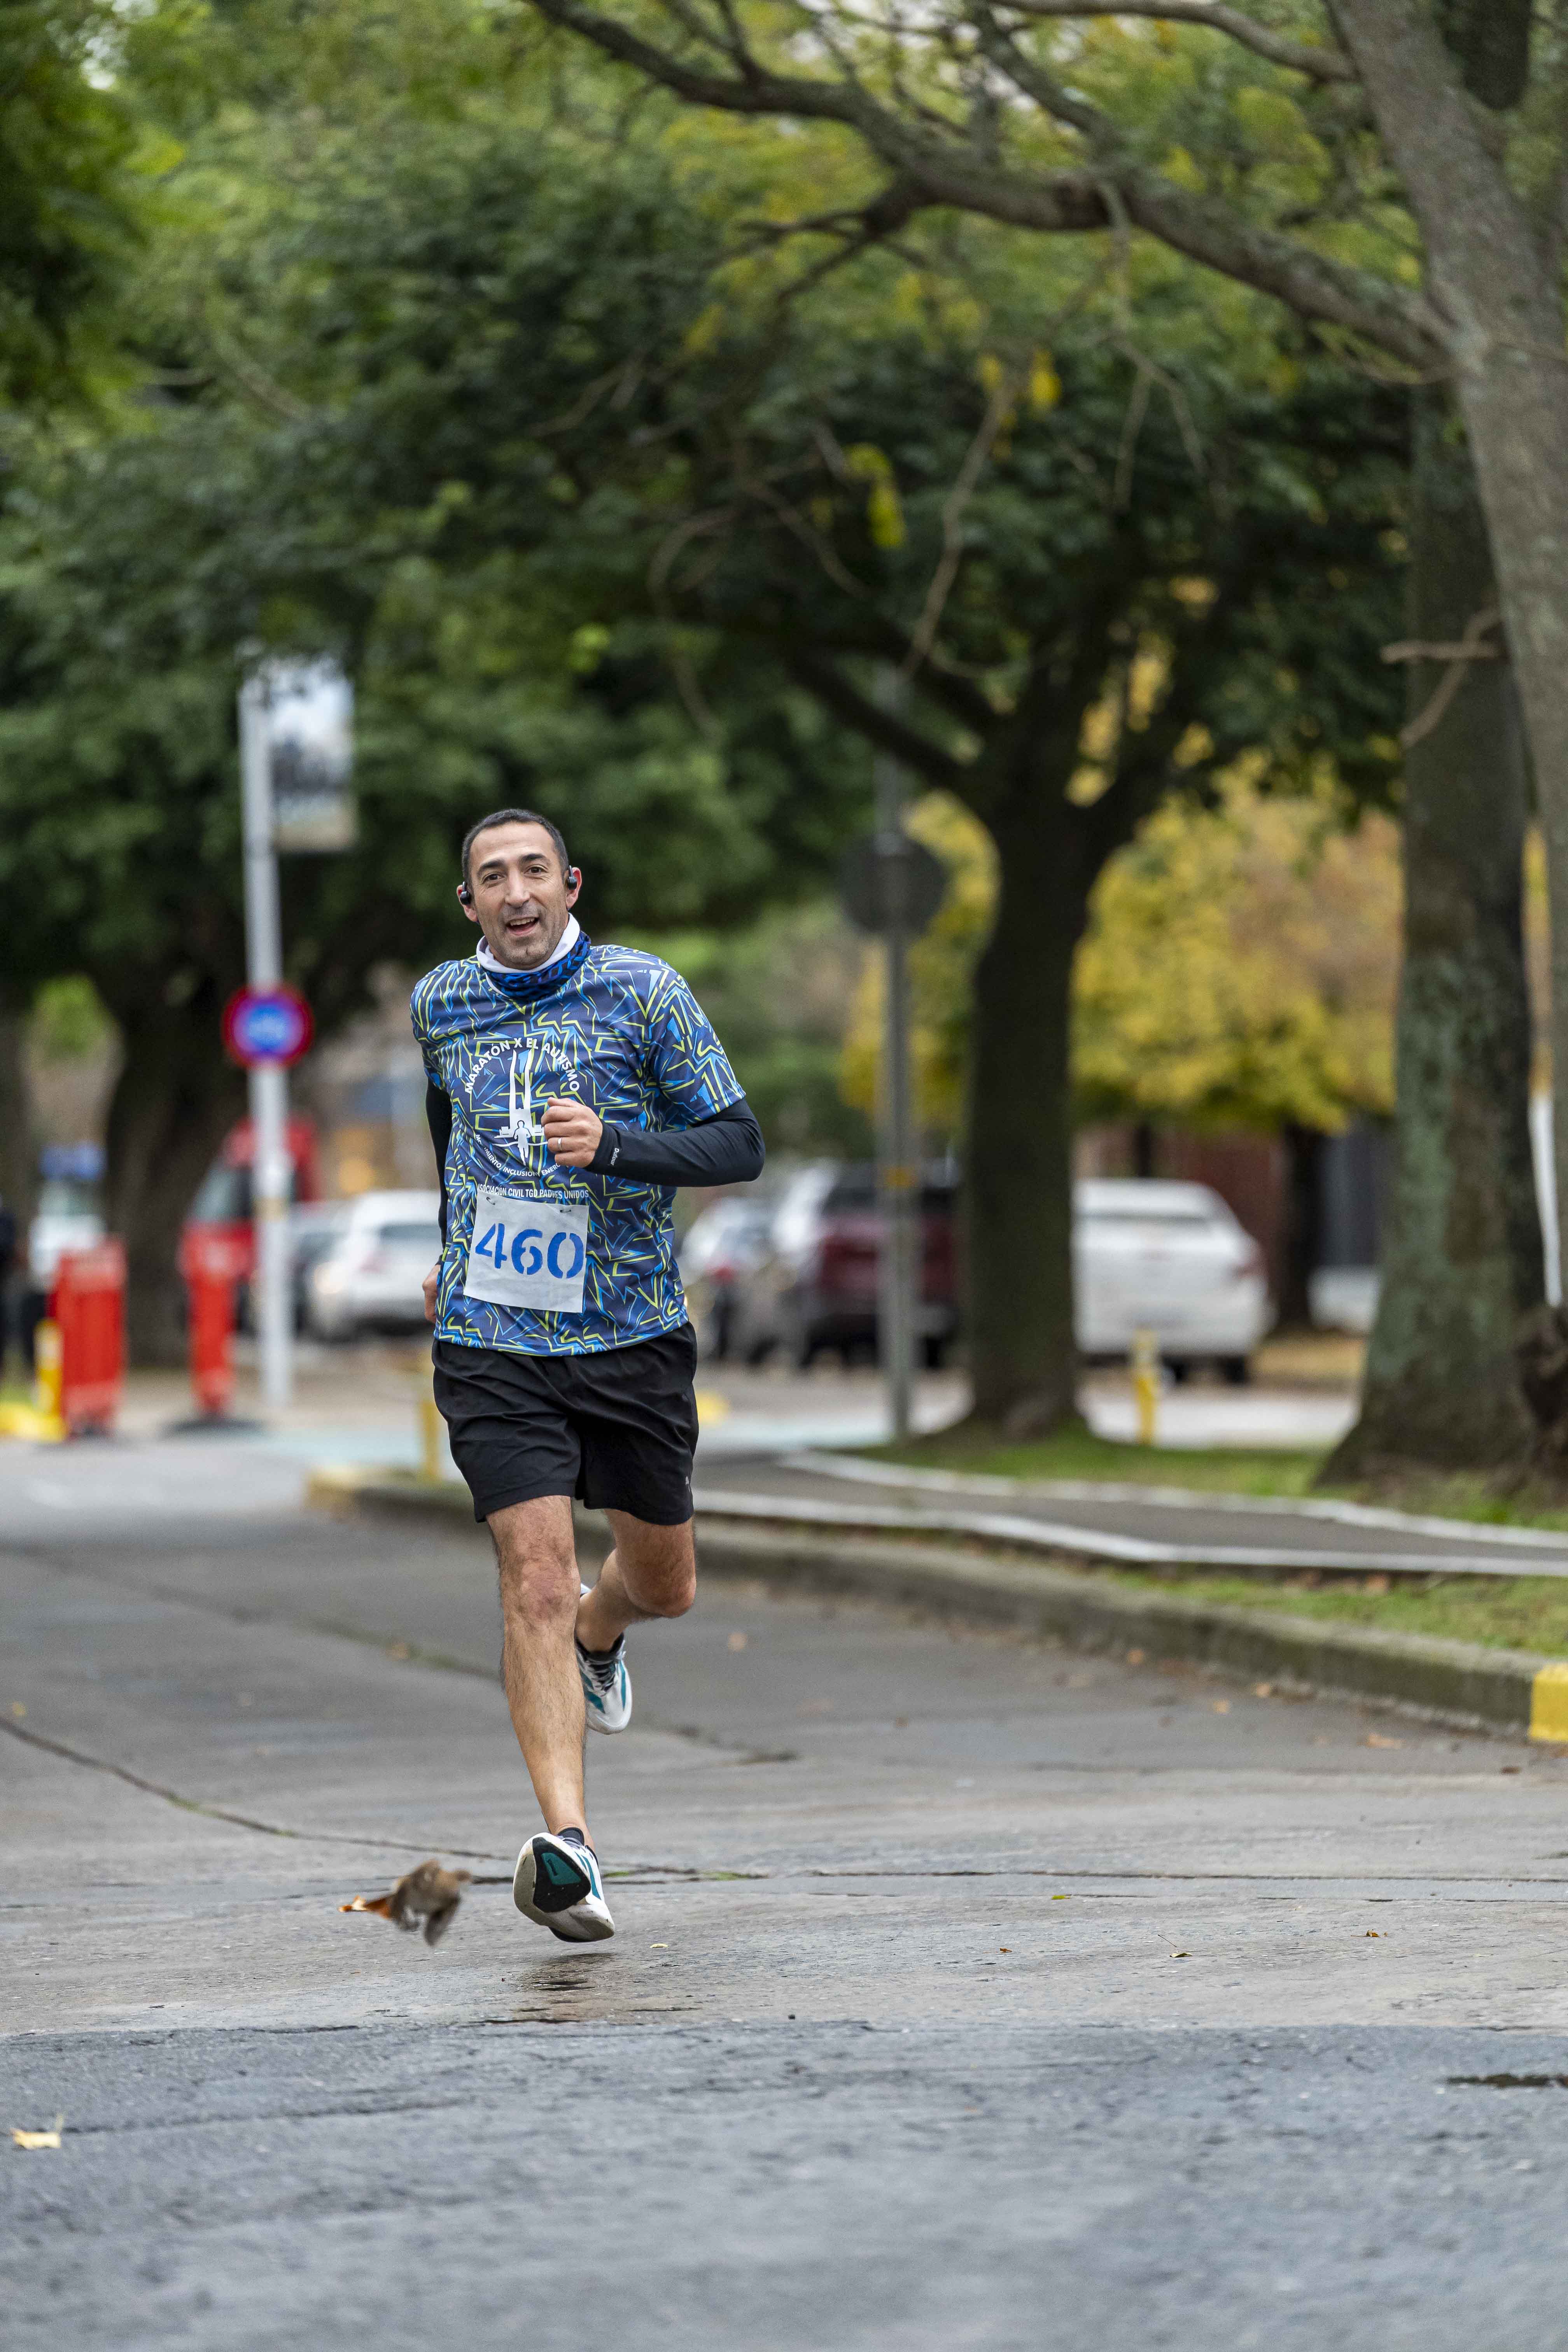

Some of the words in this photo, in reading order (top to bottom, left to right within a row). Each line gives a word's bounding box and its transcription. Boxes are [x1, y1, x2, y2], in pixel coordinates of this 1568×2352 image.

[465, 1040, 510, 1094] MARATÓN
[514, 1038, 523, 1048] X
[526, 1038, 539, 1049] EL
[541, 1043, 580, 1091] AUTISMO
[508, 1188, 524, 1197] CIVIL
[525, 1189, 538, 1198] TGD
[564, 1190, 589, 1199] UNIDOS
[475, 1223, 584, 1279] 460
